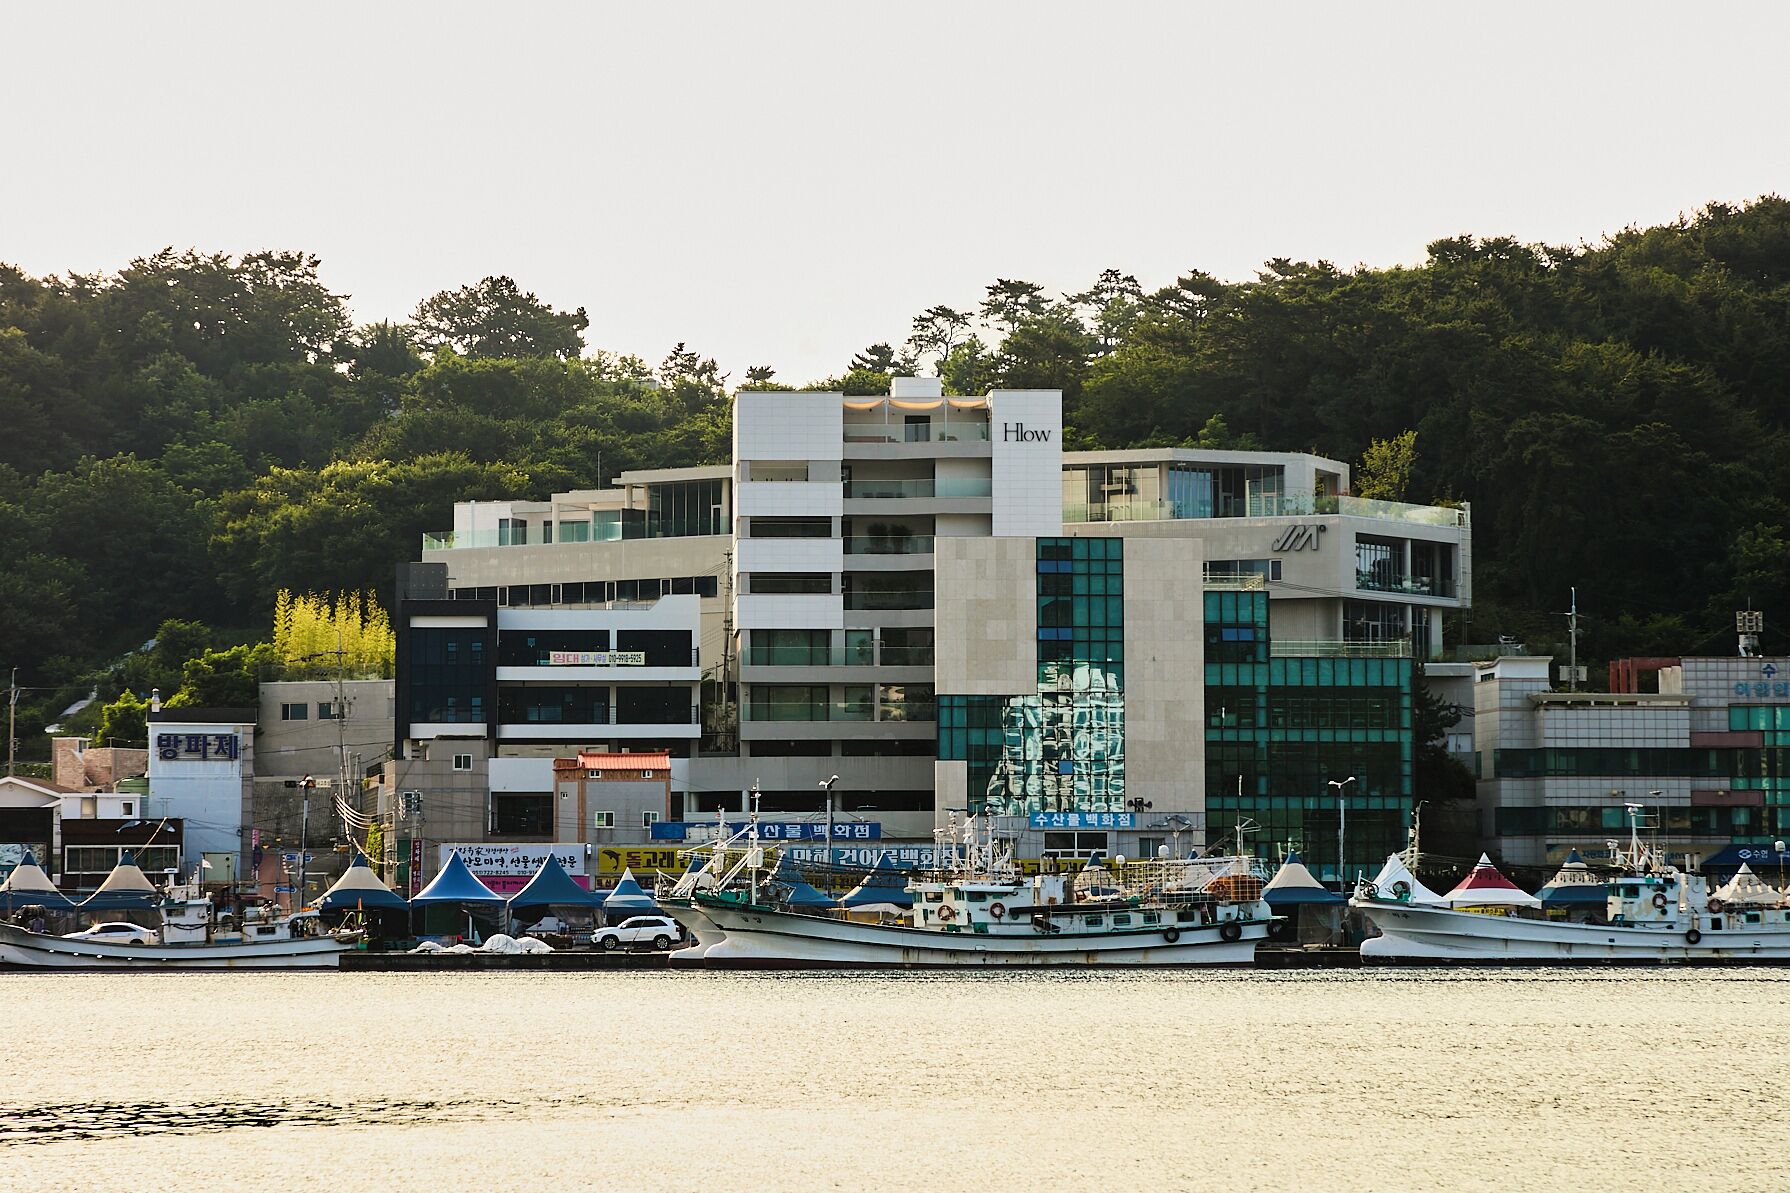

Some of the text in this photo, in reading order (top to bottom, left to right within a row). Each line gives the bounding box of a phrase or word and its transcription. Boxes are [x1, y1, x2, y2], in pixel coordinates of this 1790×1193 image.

[1003, 422, 1051, 442] Hlow
[552, 653, 579, 664] 임대
[157, 735, 238, 760] 방파제
[1035, 813, 1131, 827] 수산물 백화점
[813, 824, 870, 839] 백화점
[626, 851, 675, 869] 돌고래
